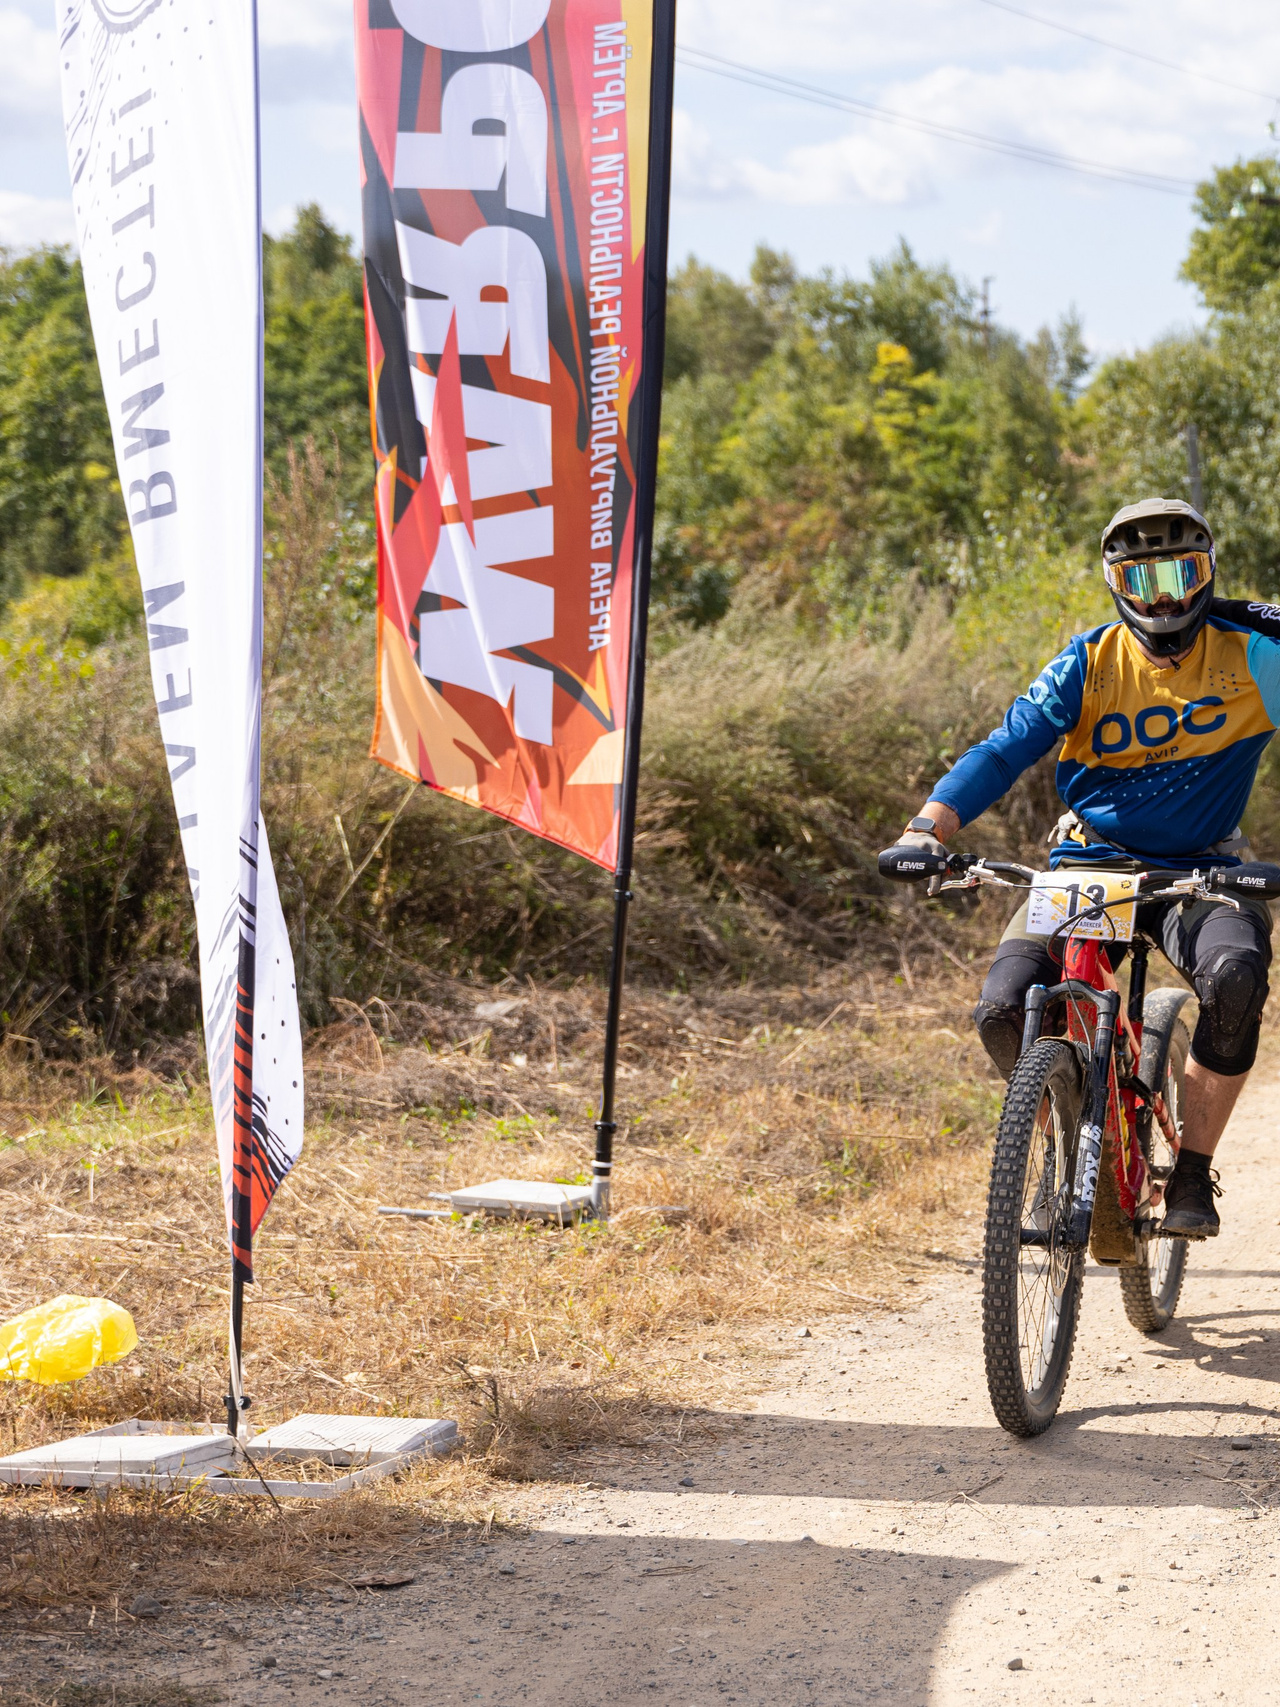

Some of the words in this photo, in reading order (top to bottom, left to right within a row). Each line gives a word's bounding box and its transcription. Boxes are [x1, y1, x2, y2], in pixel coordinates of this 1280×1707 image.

[1144, 746, 1179, 762] AVIP
[897, 861, 926, 870] LEWIS
[1236, 876, 1266, 886] LEWIS
[1081, 1151, 1101, 1203] FOX
